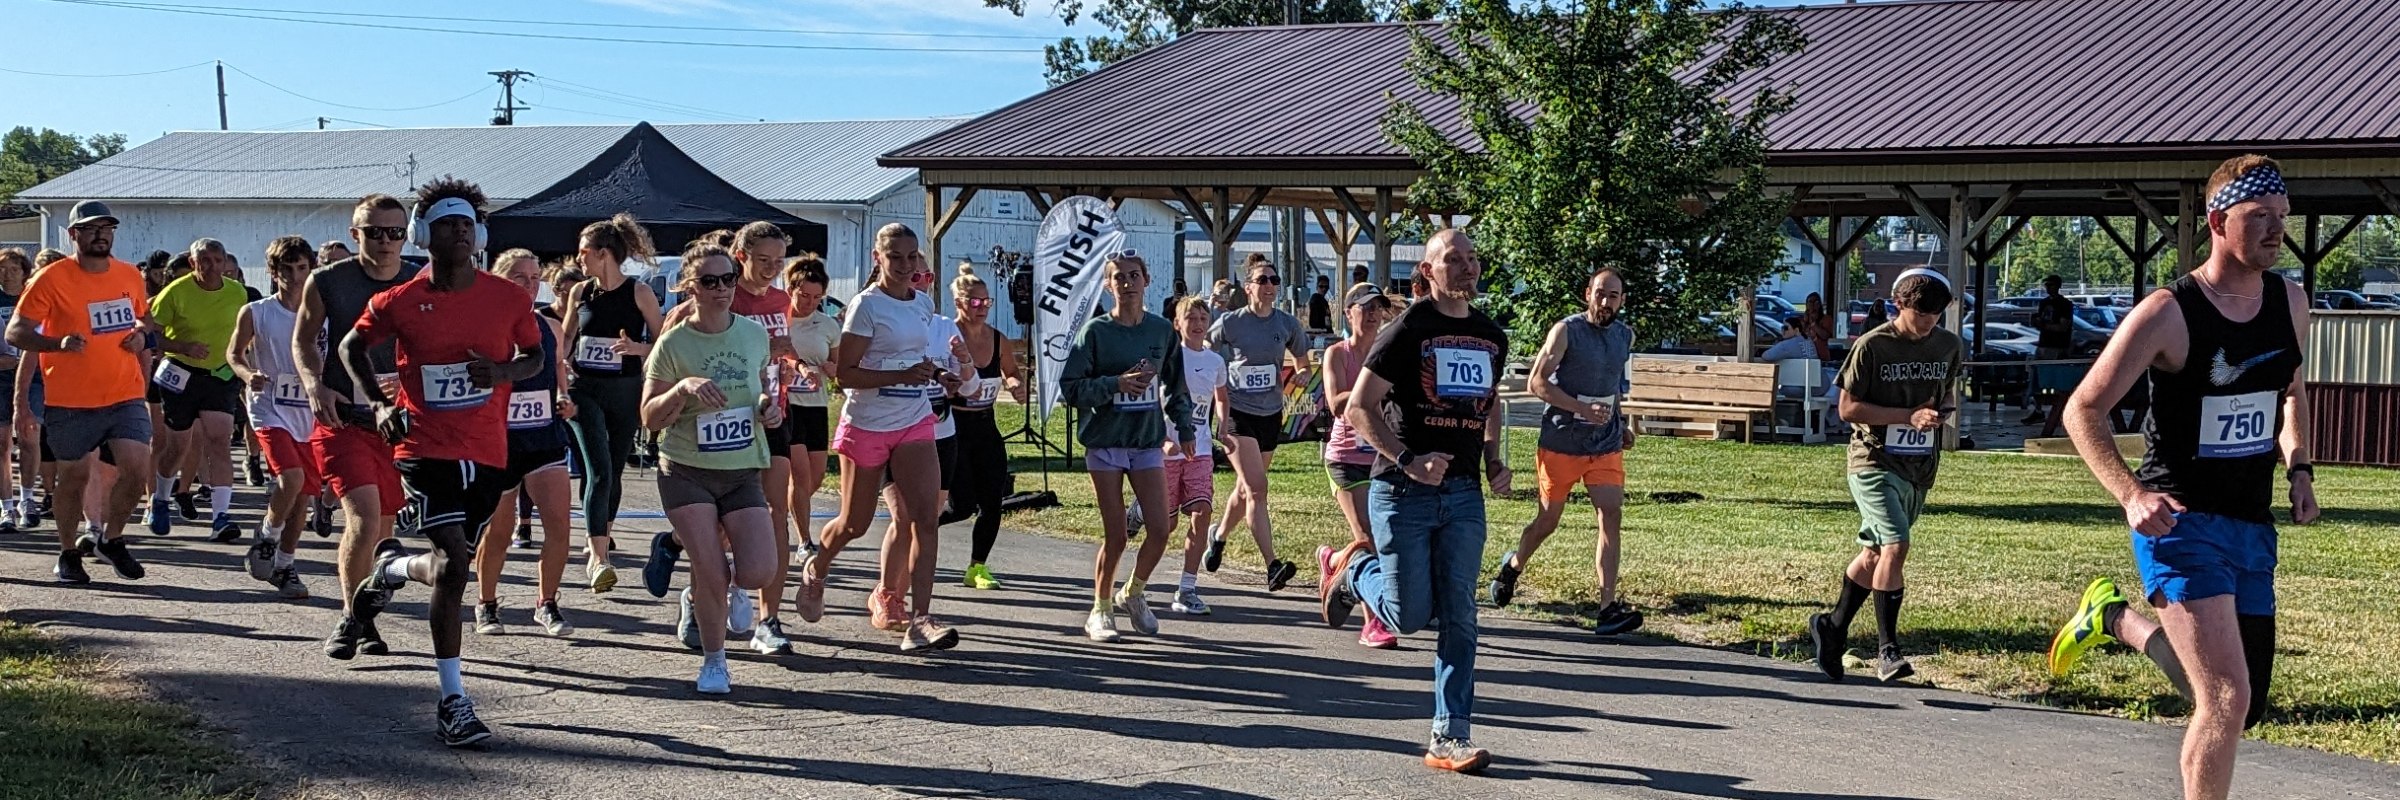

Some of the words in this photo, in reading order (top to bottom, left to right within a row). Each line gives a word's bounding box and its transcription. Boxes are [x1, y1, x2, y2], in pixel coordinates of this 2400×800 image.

[1038, 210, 1105, 316] FINISH
[1077, 296, 1087, 312] DAY
[93, 307, 133, 326] 1118
[585, 345, 614, 361] 725
[1245, 373, 1271, 387] 855
[1447, 362, 1484, 384] 703
[510, 402, 543, 419] 738
[703, 419, 752, 442] 1026
[1424, 415, 1458, 428] CEDAR
[2218, 410, 2265, 441] 750
[1896, 428, 1927, 446] 706
